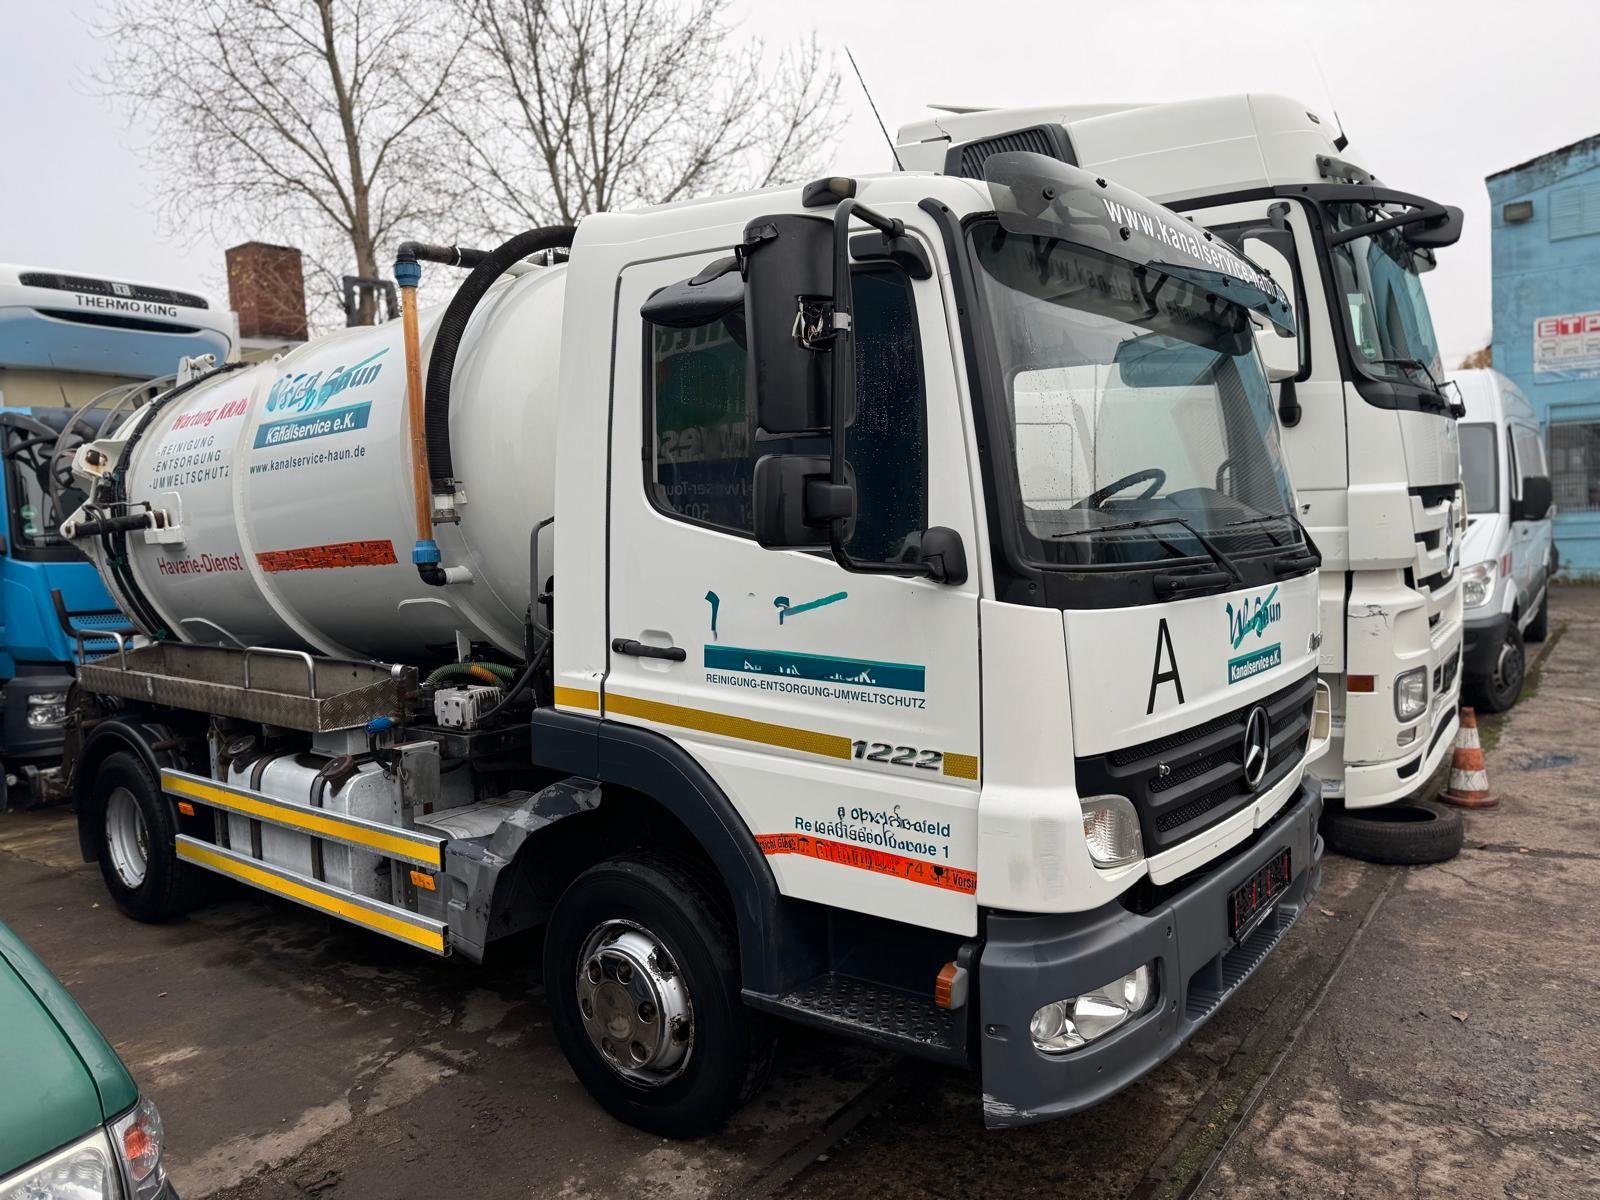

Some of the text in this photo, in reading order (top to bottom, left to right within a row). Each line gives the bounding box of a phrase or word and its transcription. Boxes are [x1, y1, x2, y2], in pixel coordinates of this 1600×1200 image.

[75, 294, 177, 317] THERMO KING
[250, 445, 365, 474] www.kanalservice-haun.de
[157, 552, 243, 576] Havarie-Dienst
[1146, 618, 1185, 715] A
[852, 739, 943, 771] 1222
